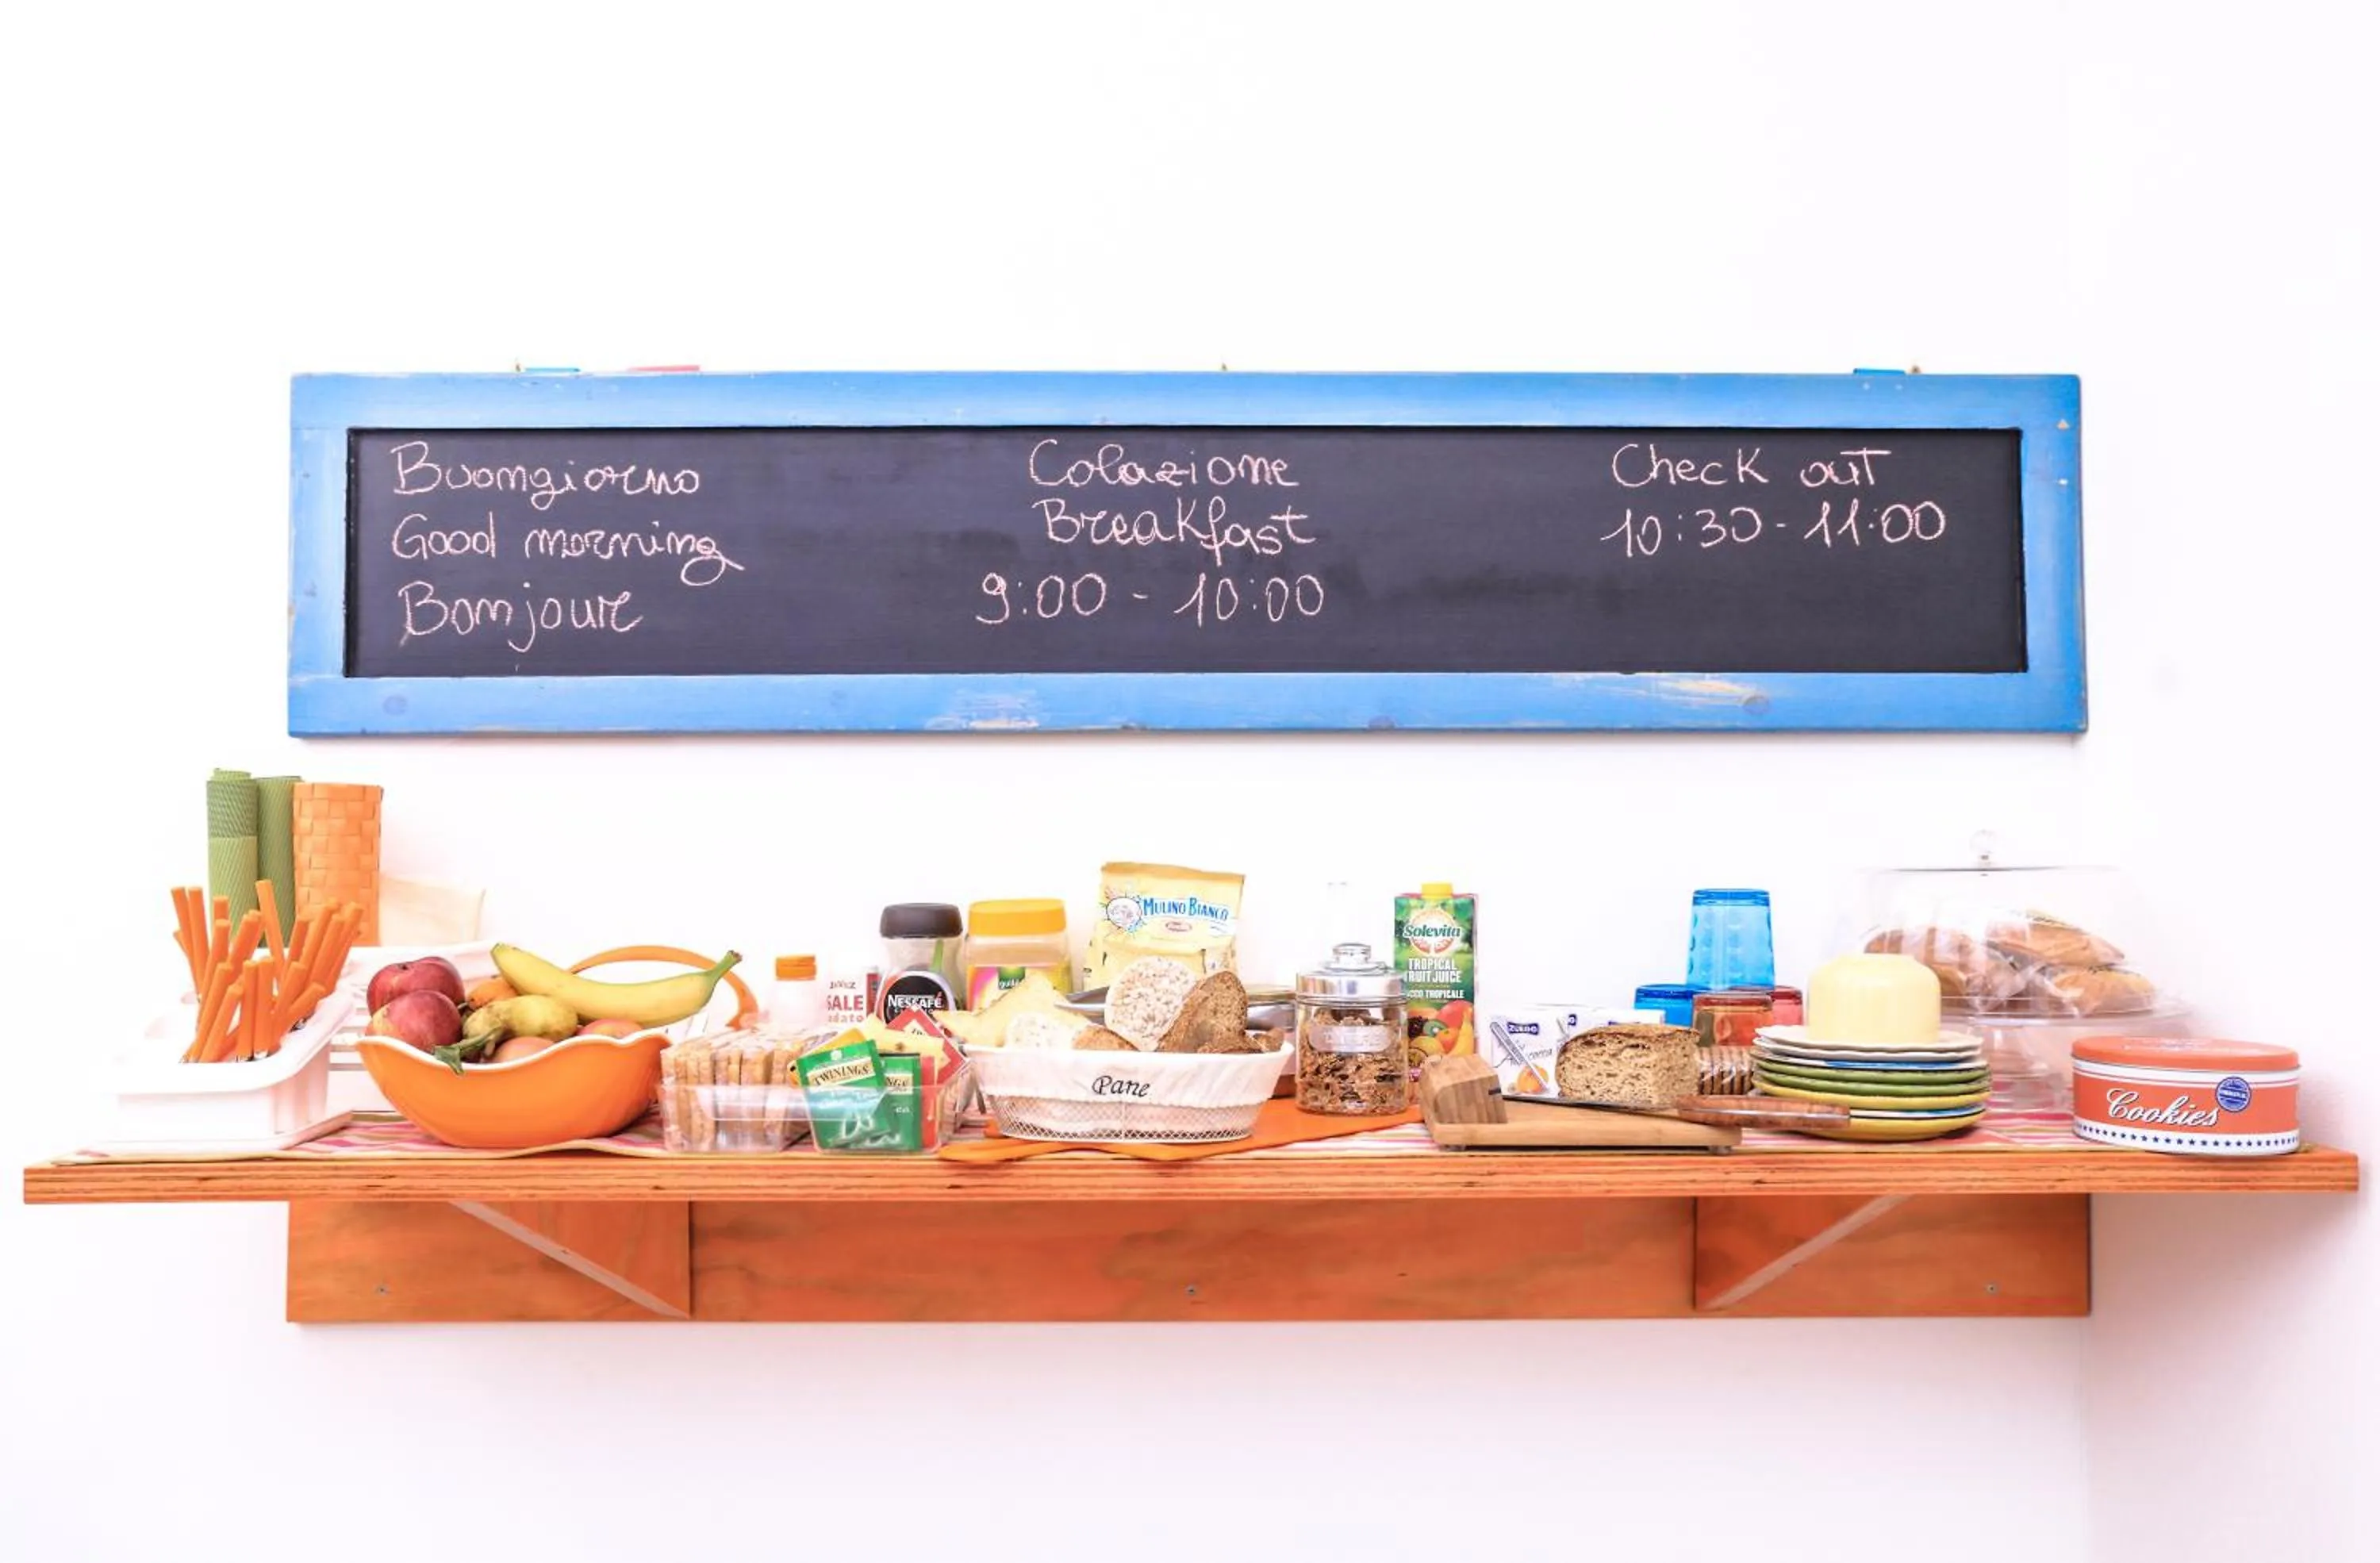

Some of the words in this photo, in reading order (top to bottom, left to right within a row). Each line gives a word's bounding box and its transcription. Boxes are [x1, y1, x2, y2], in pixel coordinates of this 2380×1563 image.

[390, 440, 700, 510] Buongiorno
[1030, 439, 1299, 488] Colazione
[1611, 444, 1769, 488] Check
[1031, 495, 1317, 567] Breakfast
[1600, 507, 1763, 558] 10:30
[1804, 497, 1946, 547] 11:00
[391, 511, 497, 560] Good
[524, 520, 746, 588] morning
[976, 572, 1107, 624] 9:00
[1173, 572, 1324, 627] 10:00
[1143, 897, 1186, 916] MULINO
[1403, 924, 1461, 939] Solevita
[1406, 970, 1431, 983] RUIT
[1433, 970, 1462, 983] JUICE
[1408, 958, 1457, 970] TROPICAL
[814, 1064, 869, 1085] TWININGS
[1092, 1075, 1150, 1097] Pane
[2106, 1088, 2220, 1127] Cookies
